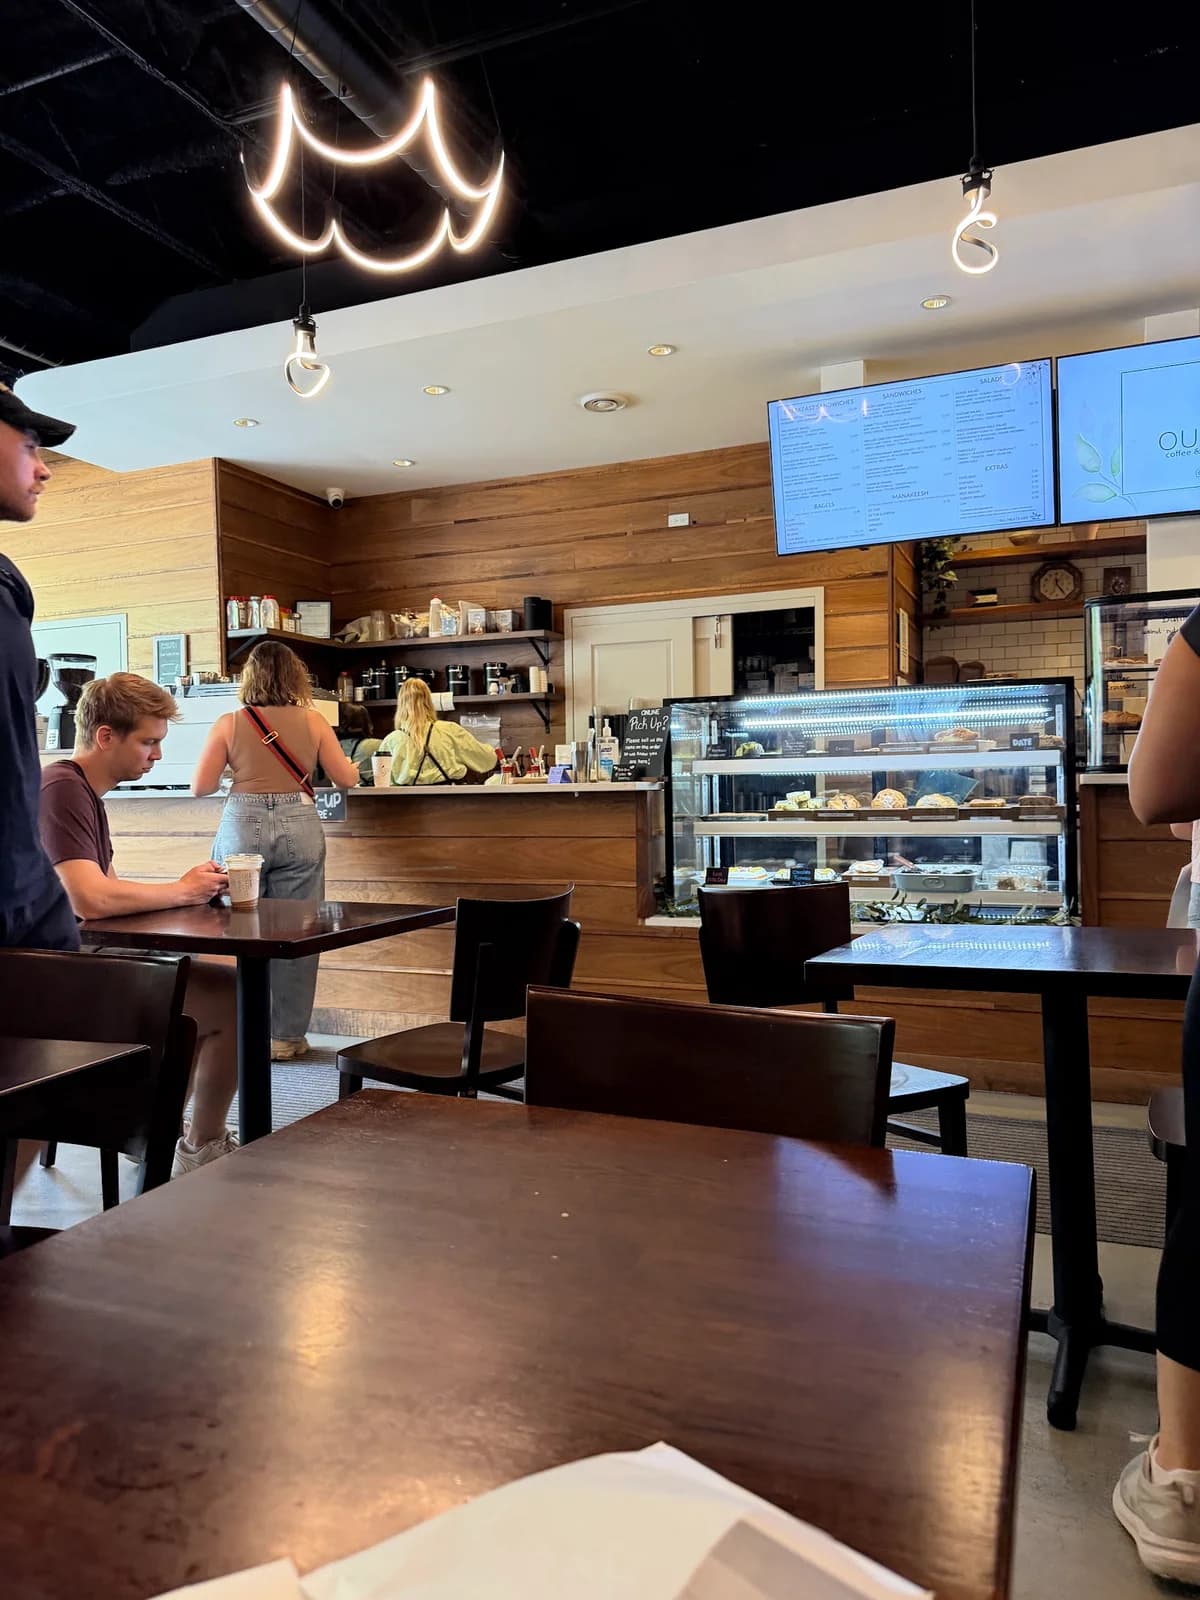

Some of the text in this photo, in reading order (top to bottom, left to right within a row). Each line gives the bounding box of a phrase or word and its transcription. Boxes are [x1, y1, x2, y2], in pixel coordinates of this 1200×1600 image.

[1165, 450, 1192, 458] coffee
[985, 463, 1009, 472] EXTRAS
[650, 715, 669, 732] Up?
[1012, 738, 1033, 746] DATE
